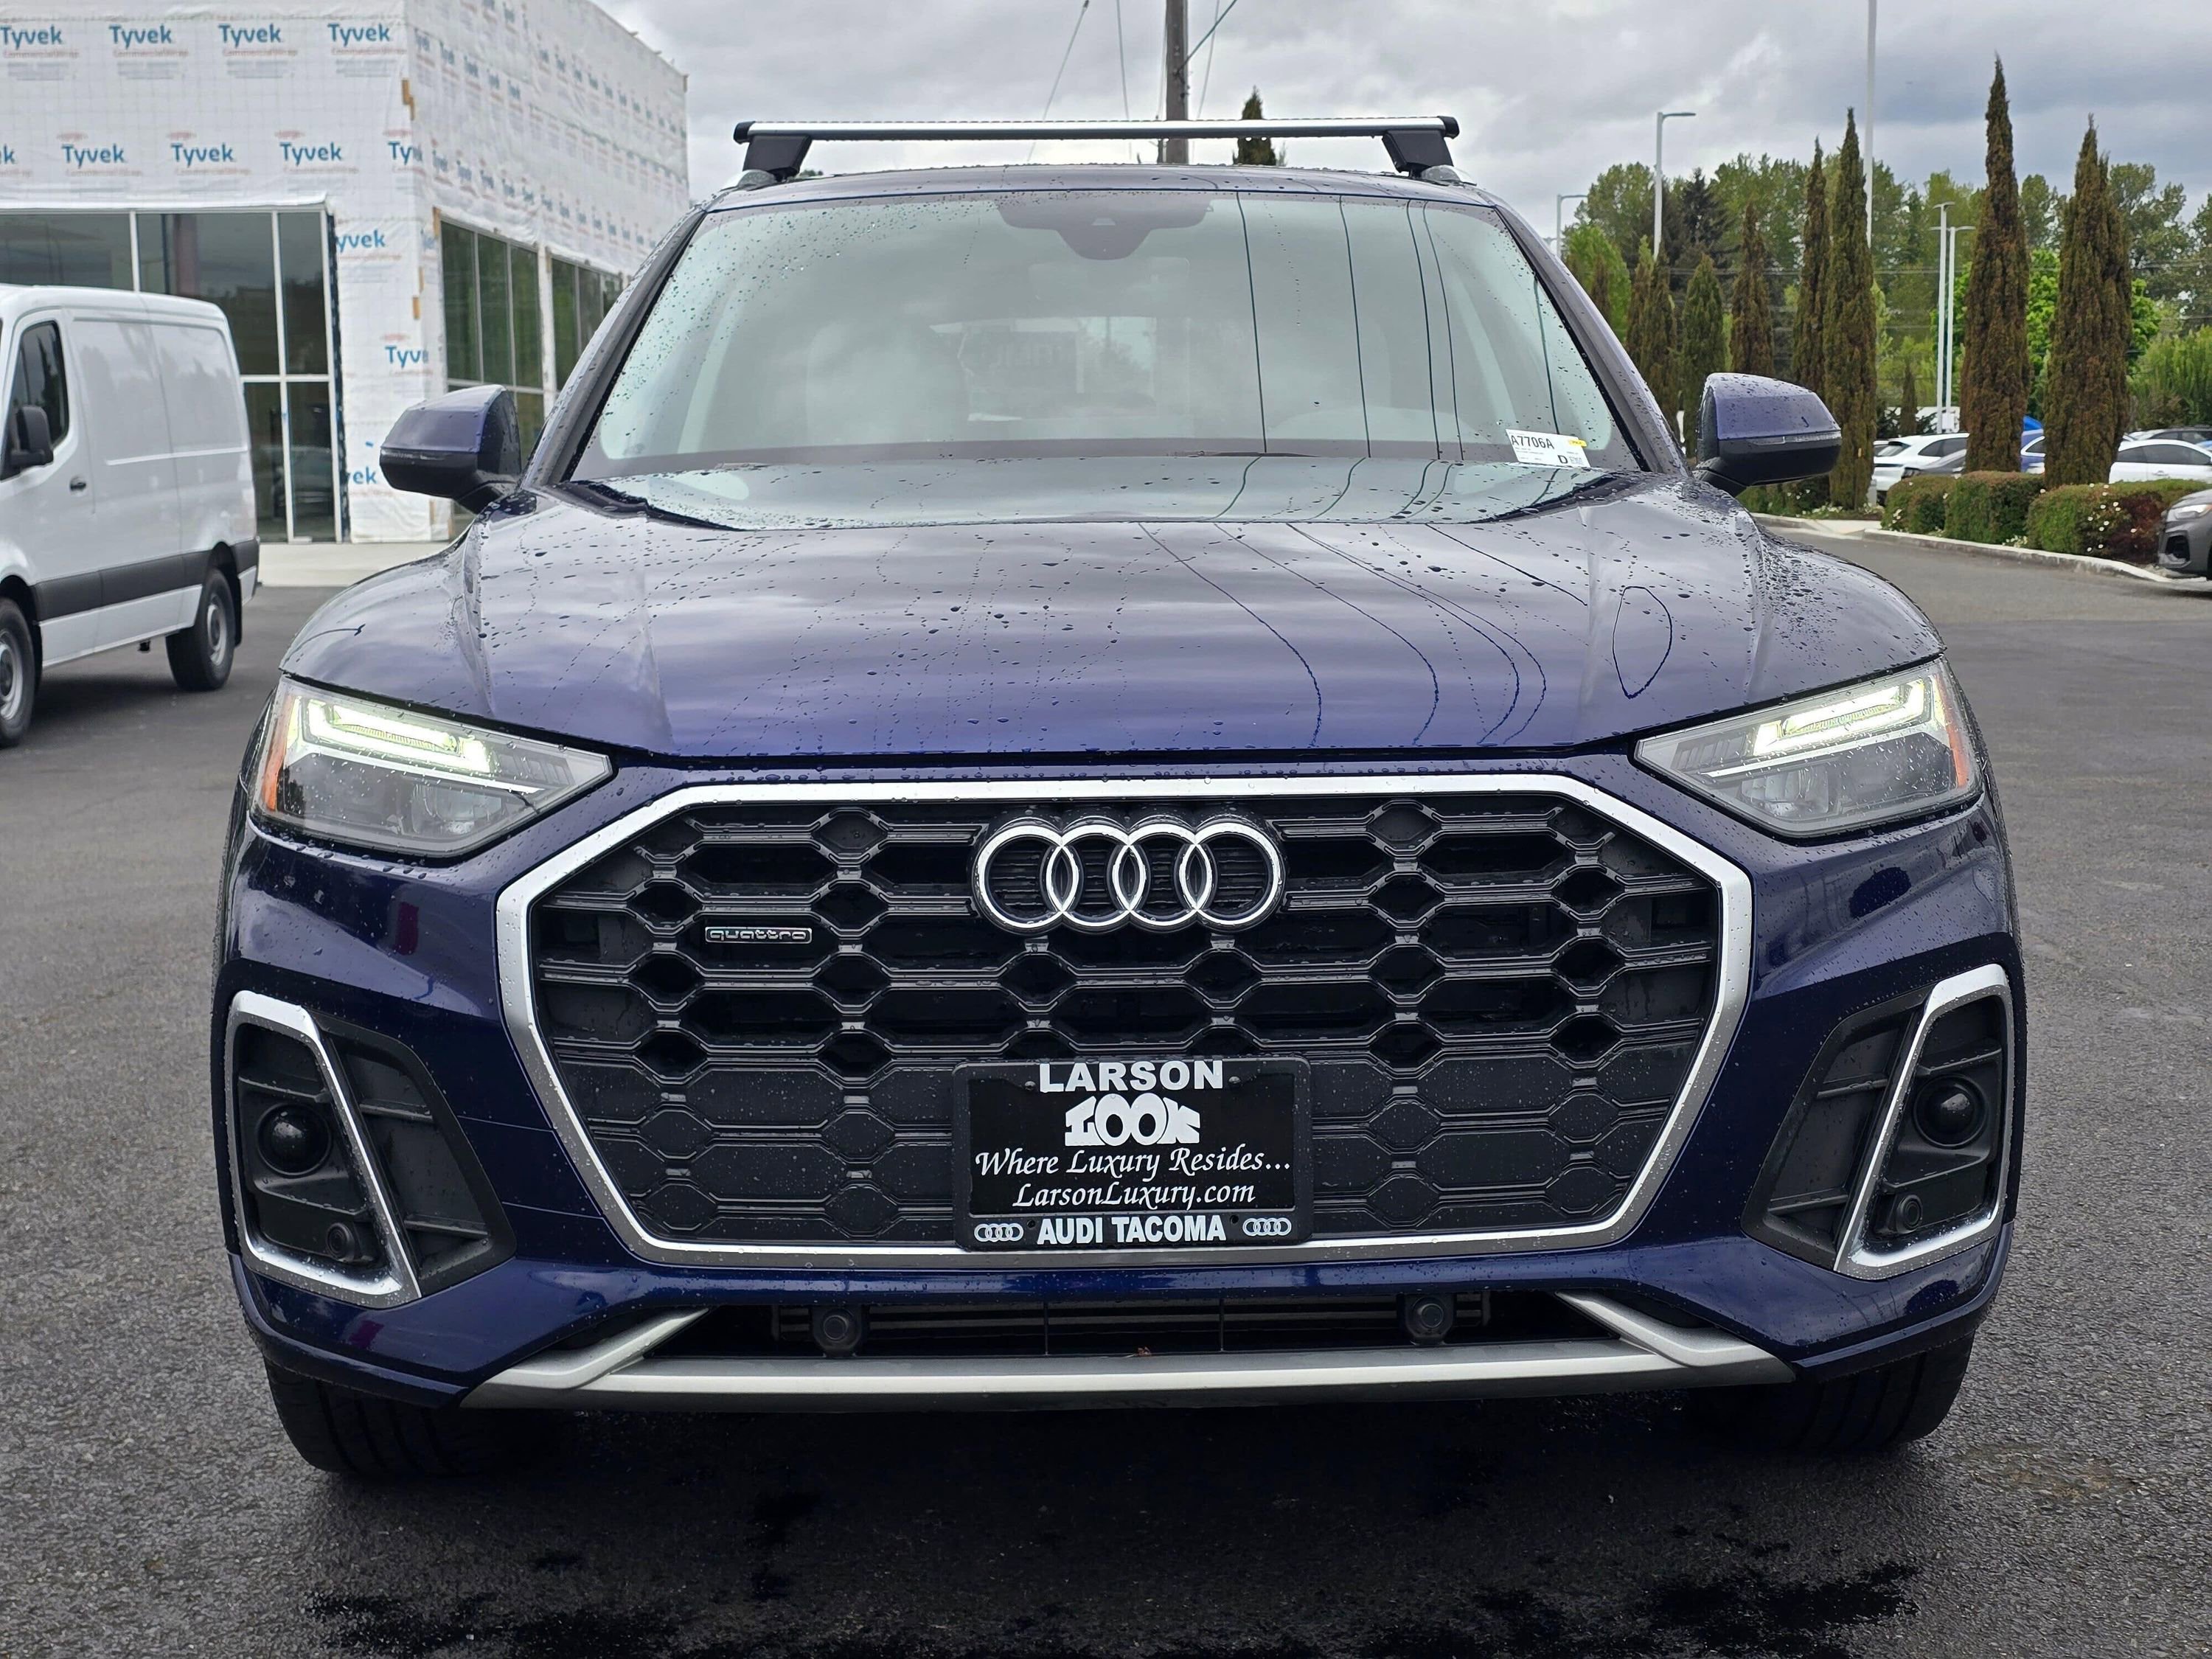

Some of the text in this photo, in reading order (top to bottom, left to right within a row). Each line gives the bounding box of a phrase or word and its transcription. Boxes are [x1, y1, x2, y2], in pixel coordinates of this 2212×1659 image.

[0, 25, 63, 49] Tyvek
[109, 24, 172, 49] Tyvek
[218, 23, 282, 47] Tyvek
[327, 23, 390, 46] Tyvek
[61, 142, 125, 168] Tyvek
[171, 142, 234, 167] Tyvek
[279, 141, 342, 166] Tyvek
[1511, 435, 1555, 450] A7706A
[1557, 454, 1568, 465] D
[710, 929, 806, 941] quattro
[1039, 1060, 1223, 1093] LARSON
[975, 1144, 1291, 1182] Where Luxury Resides...
[1012, 1181, 1256, 1211] LarsonLuxury.com
[1037, 1215, 1227, 1245] AUDI TACOMA
